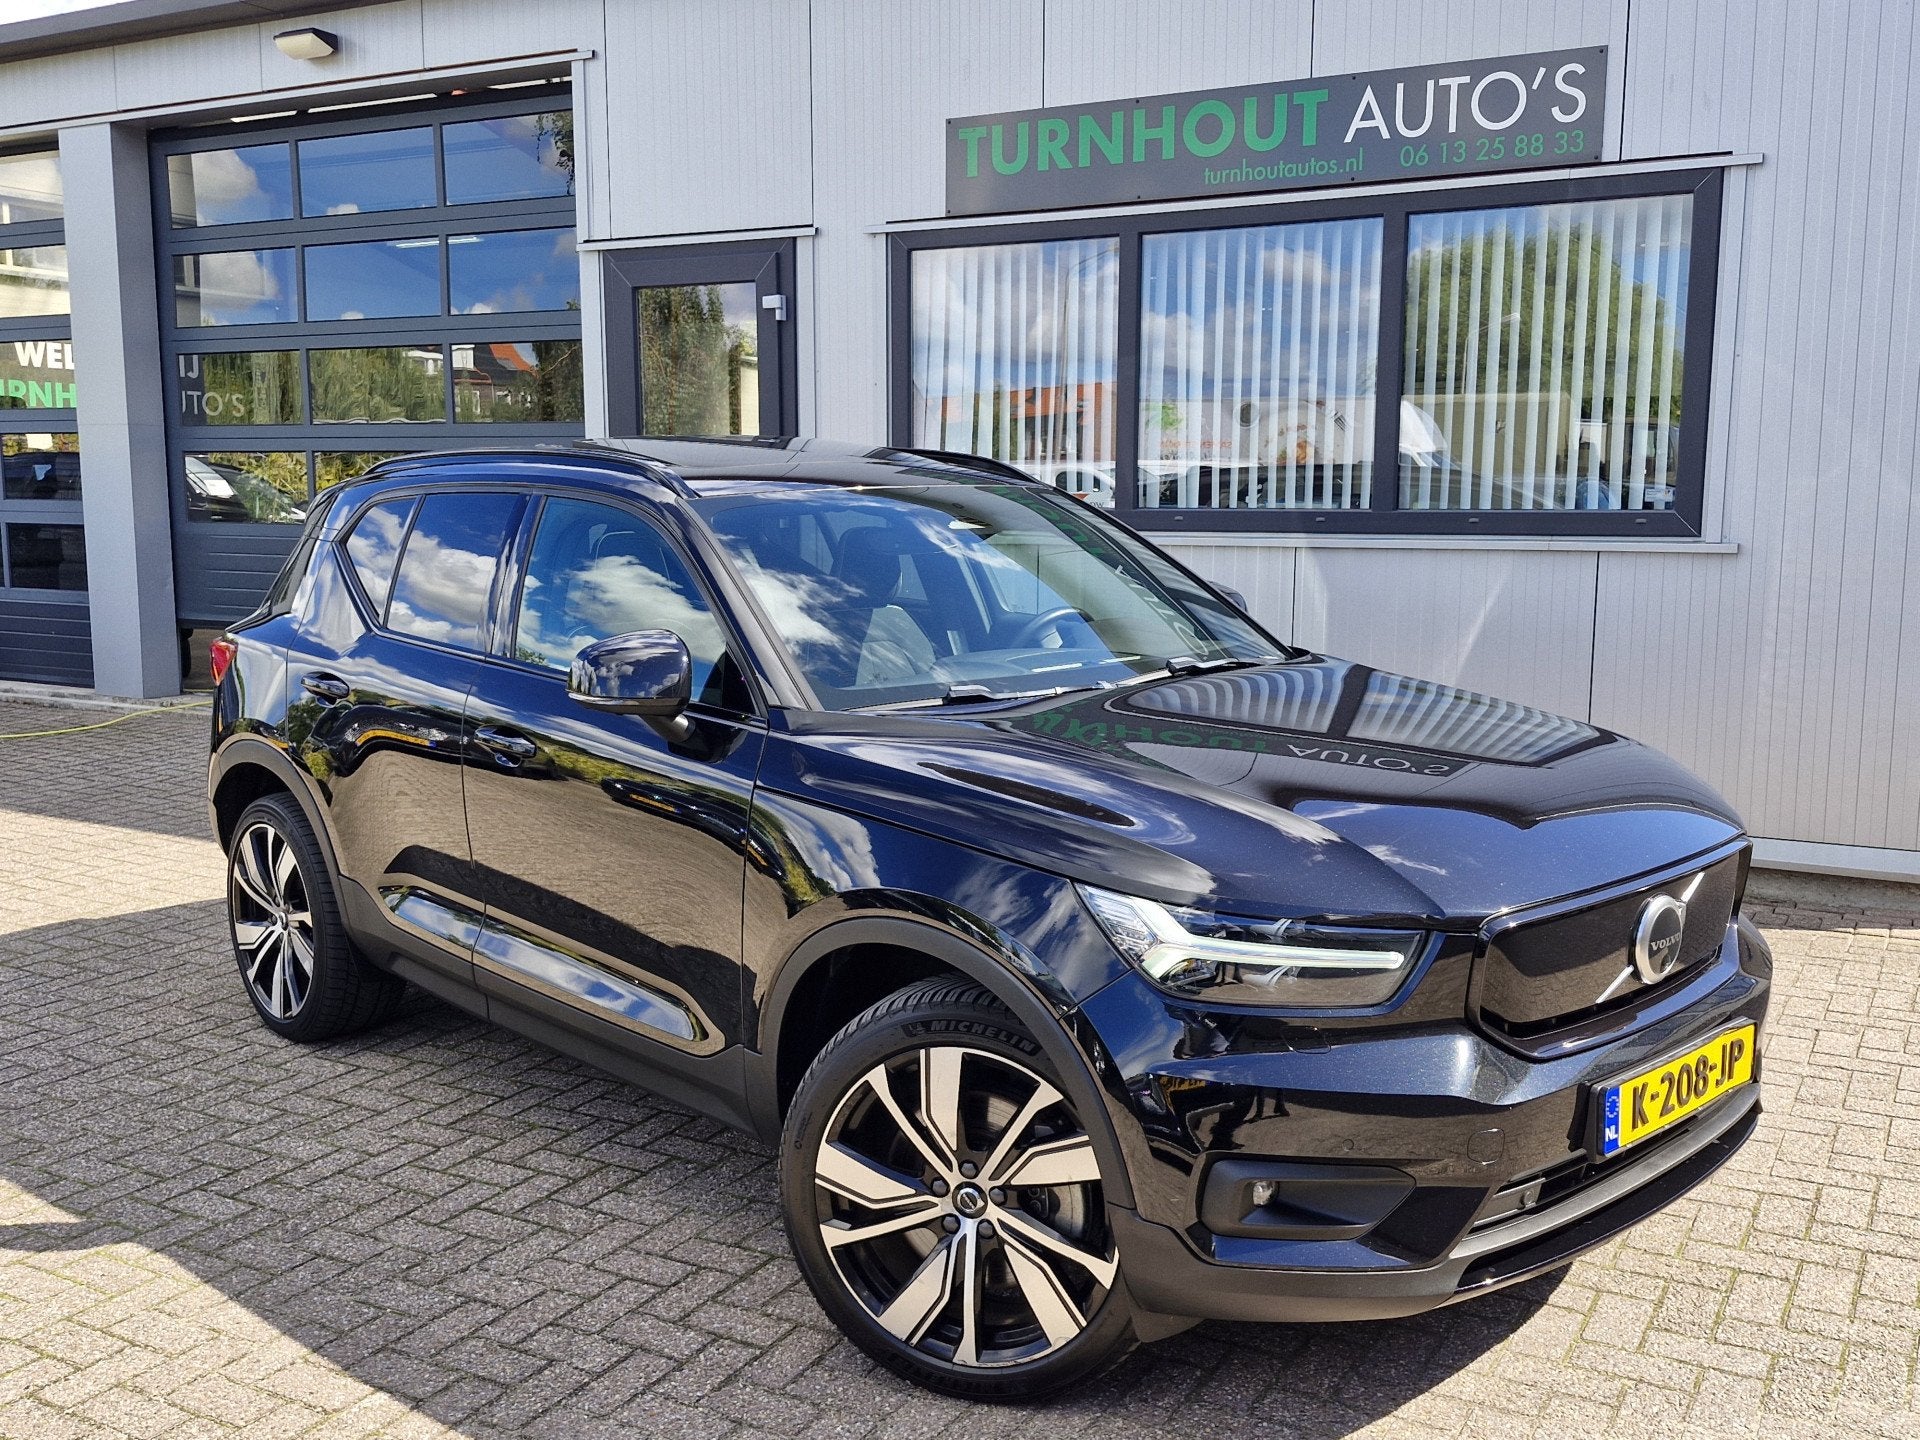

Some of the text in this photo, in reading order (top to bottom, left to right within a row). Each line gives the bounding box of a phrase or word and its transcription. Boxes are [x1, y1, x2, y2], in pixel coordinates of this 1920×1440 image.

[958, 62, 1587, 178] TURNHOUT AUTO'S
[1204, 147, 1363, 185] turnhoutautos.nl
[1400, 129, 1584, 167] 06 13 25 88 33
[1651, 932, 1681, 951] VOLVO
[931, 1020, 1036, 1052] MICHELIN
[1631, 1037, 1745, 1133] K-208-JP
[1605, 1127, 1618, 1142] NL
